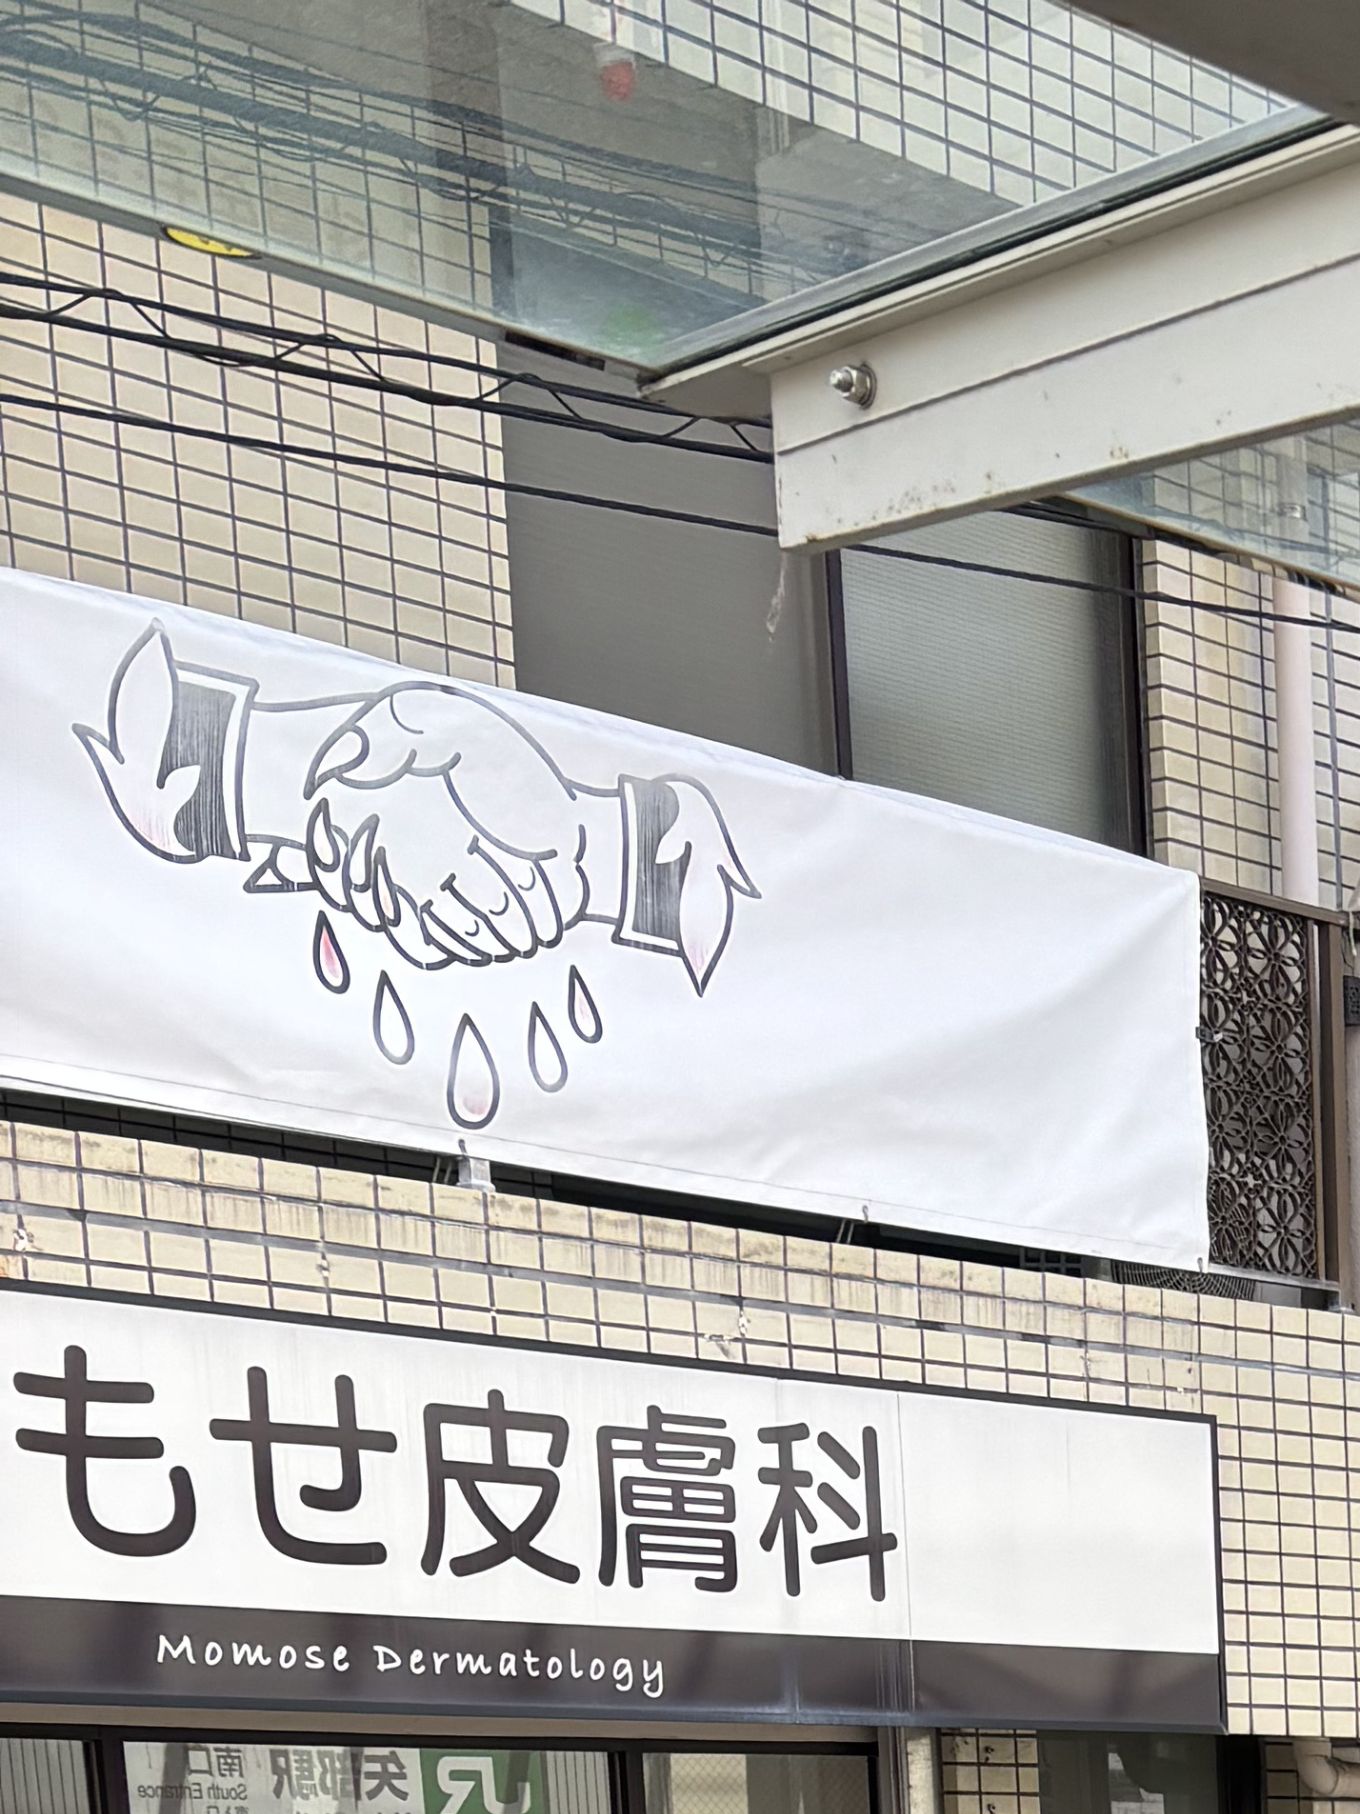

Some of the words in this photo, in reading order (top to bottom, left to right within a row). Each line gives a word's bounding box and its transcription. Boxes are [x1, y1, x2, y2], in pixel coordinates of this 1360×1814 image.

[12, 1344, 898, 1602] もせ皮膚科
[156, 1633, 351, 1674] Momose
[375, 1643, 667, 1700] Dermatology
